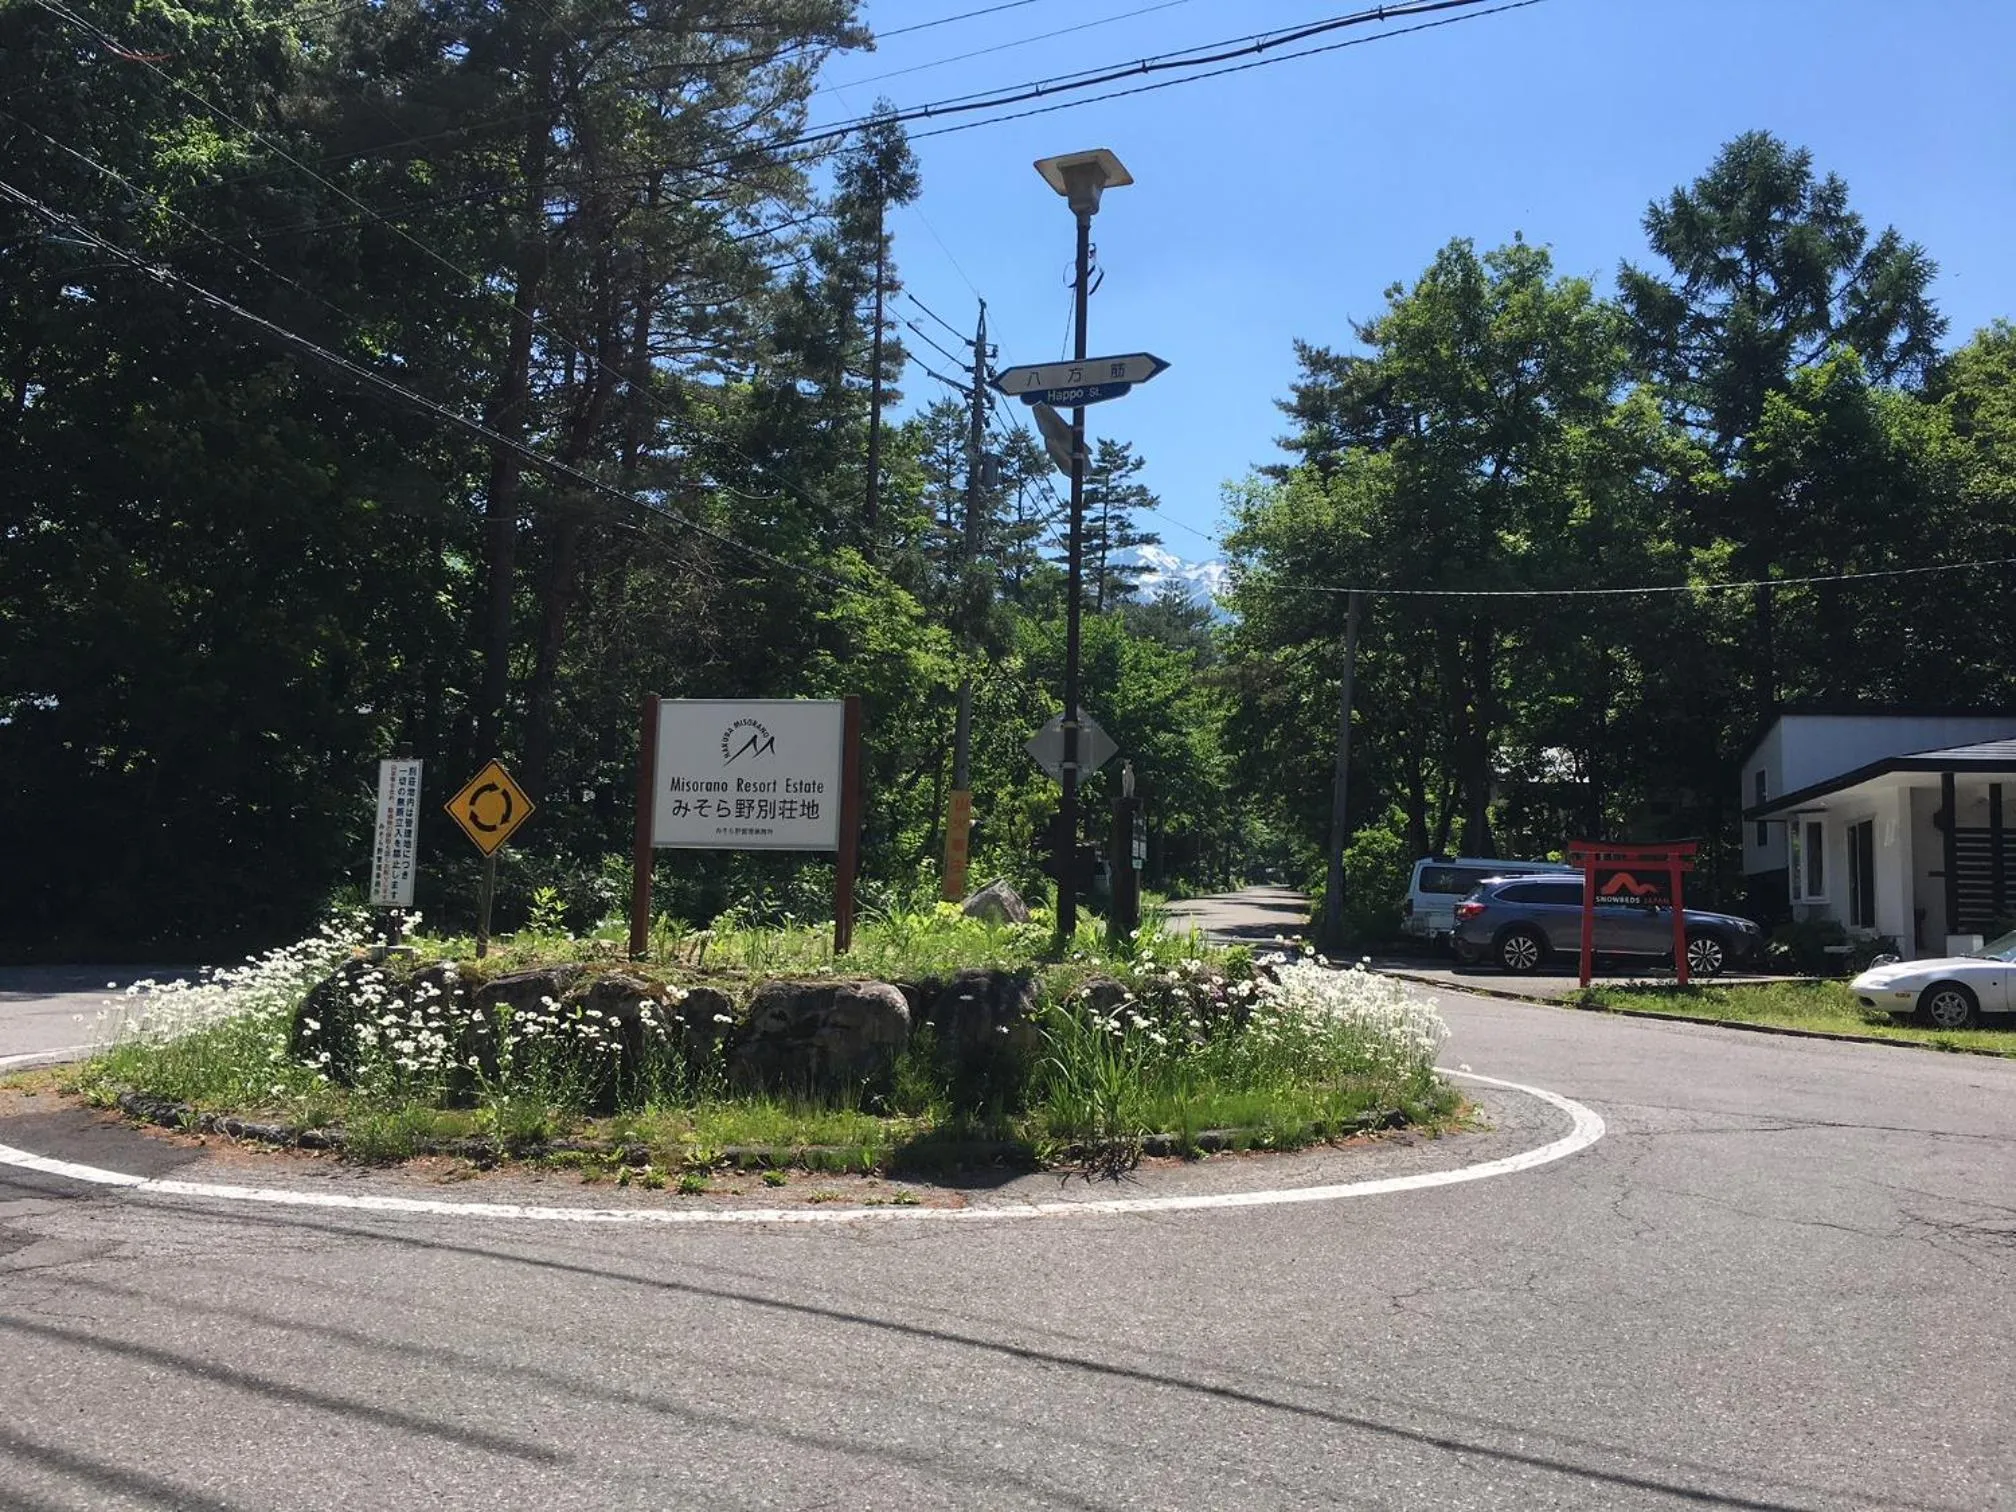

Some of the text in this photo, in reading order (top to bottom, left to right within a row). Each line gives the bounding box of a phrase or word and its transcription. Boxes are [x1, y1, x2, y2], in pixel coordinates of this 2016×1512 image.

[1047, 389, 1084, 401] Happo
[721, 718, 770, 759] HAKUBA MISORANO
[670, 776, 824, 794] Misorano Resort Estate
[672, 799, 820, 820] みそら野別荘地
